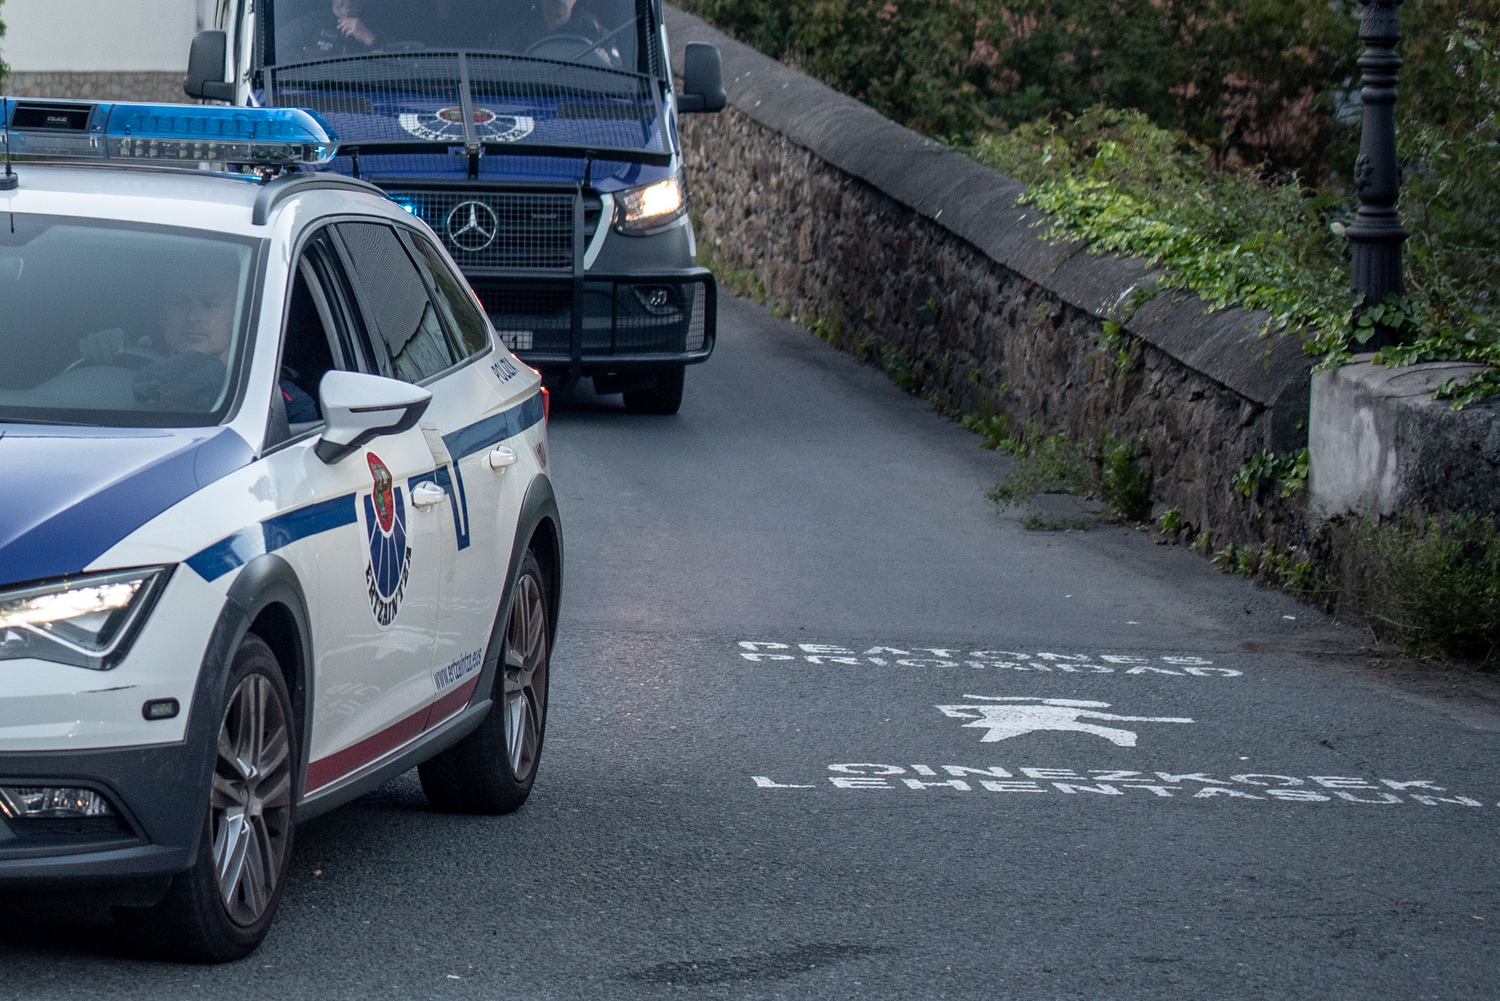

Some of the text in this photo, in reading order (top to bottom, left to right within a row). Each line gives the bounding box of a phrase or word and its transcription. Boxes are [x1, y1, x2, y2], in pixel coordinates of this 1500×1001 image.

[365, 545, 412, 627] ERTZAINTZA
[737, 640, 1214, 665] PEATONES
[750, 775, 1500, 807] LEHENTASUN
[827, 762, 1447, 791] OINEZKOEK
